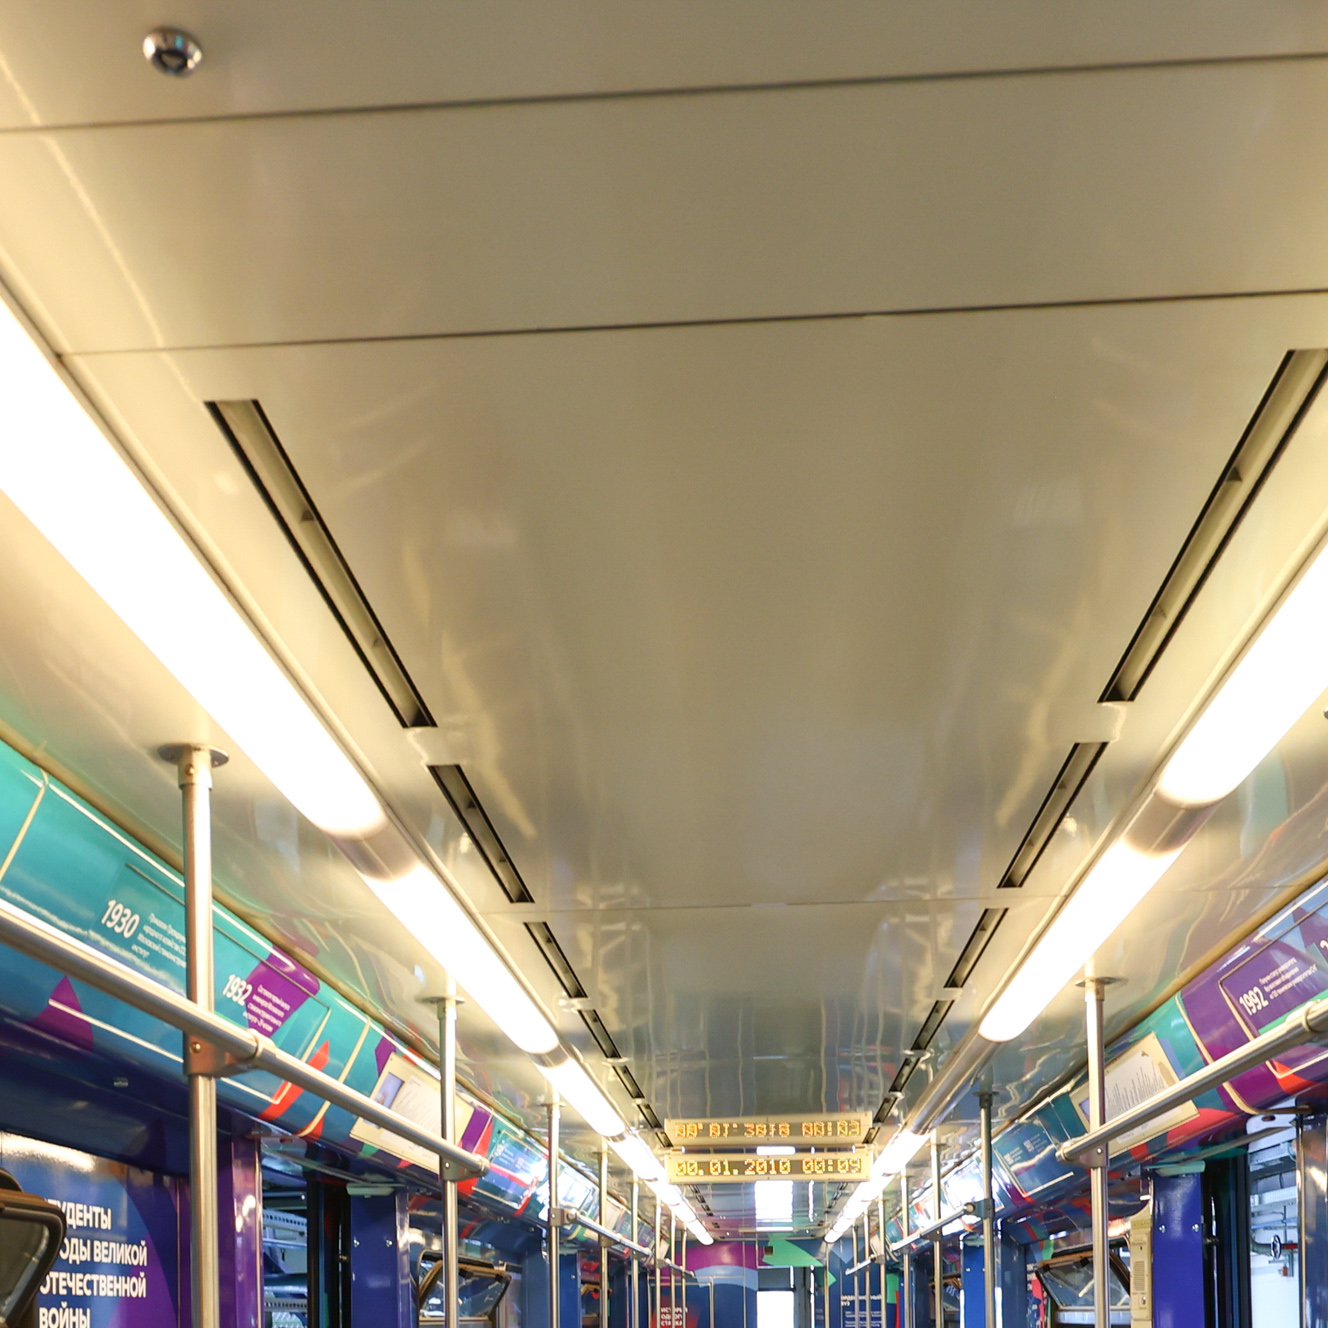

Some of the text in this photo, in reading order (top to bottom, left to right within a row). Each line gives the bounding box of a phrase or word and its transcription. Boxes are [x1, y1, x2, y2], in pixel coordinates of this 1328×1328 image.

[101, 899, 140, 939] 1930
[223, 974, 253, 1006] 1932
[1239, 986, 1270, 1016] 1992
[676, 1160, 791, 1176] 00.01.2010
[59, 1237, 148, 1267] ОДЫ ВЕЛИКОЙ
[39, 1271, 147, 1298] ОТЕЧЕСТВЕННОЙ
